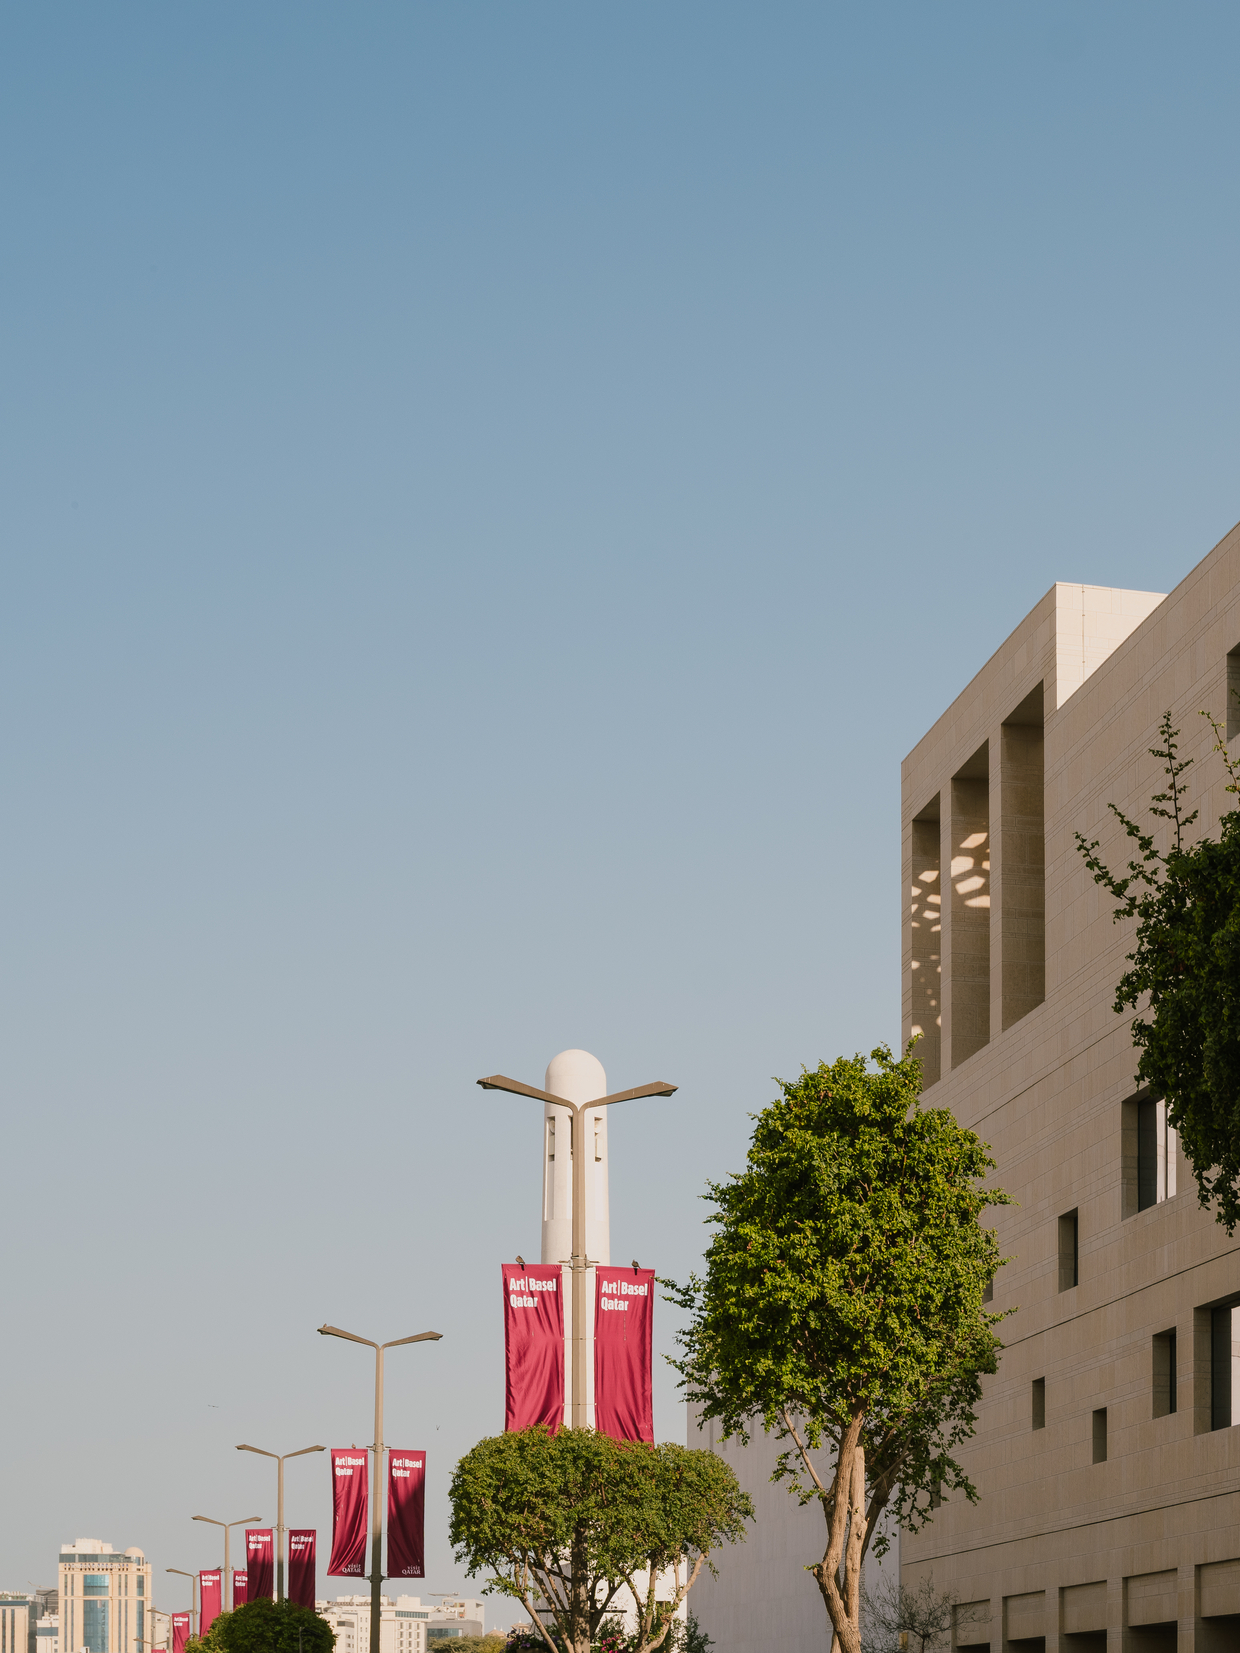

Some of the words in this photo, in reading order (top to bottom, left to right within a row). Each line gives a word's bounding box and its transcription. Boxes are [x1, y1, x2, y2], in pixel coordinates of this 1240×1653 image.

[510, 1294, 538, 1308] Qatar
[601, 1297, 628, 1311] Qatar
[335, 1467, 353, 1476] Qatar
[392, 1468, 410, 1477] Qatar
